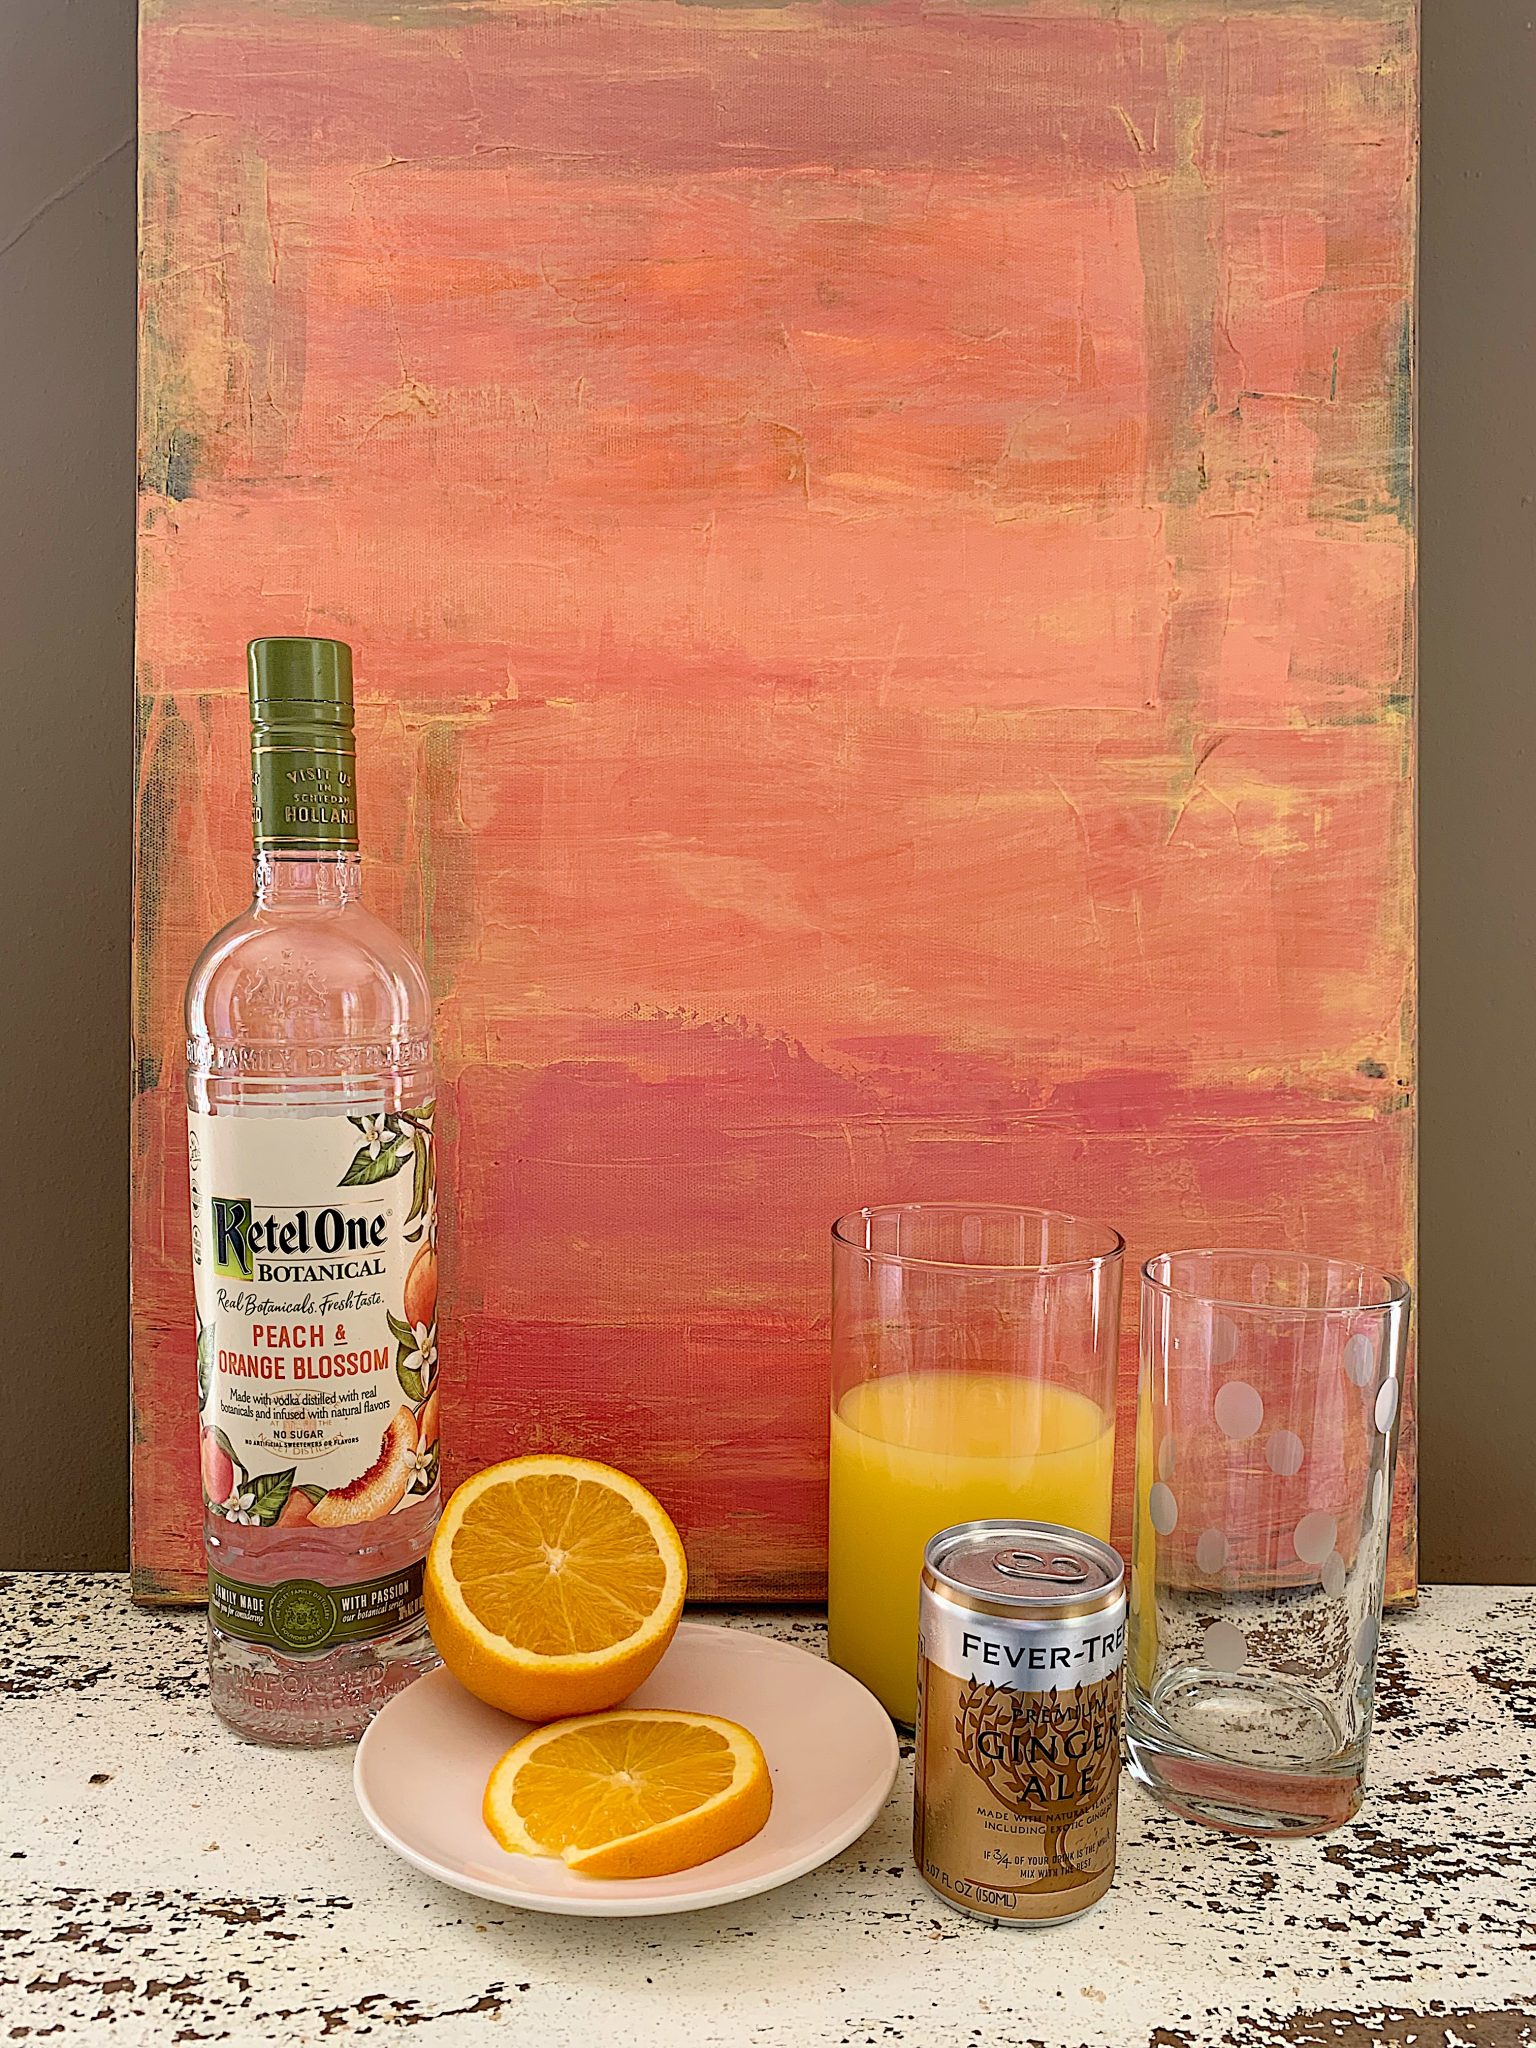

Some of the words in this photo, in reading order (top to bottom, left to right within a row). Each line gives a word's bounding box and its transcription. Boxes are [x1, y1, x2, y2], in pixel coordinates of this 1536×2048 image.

[286, 768, 331, 783] VISIT
[339, 771, 352, 786] US
[317, 784, 331, 792] IN
[285, 806, 355, 824] HOLLAND
[213, 1202, 311, 1275] Ketel
[314, 1208, 389, 1253] One
[257, 1259, 386, 1283] BOTANICAL
[217, 1288, 245, 1312] Real
[245, 1293, 317, 1316] Botanicals.
[319, 1290, 354, 1316] Fresh
[355, 1290, 385, 1310] taste.
[253, 1324, 324, 1348] PEACH
[334, 1324, 348, 1344] &
[219, 1349, 286, 1379] ORANGE
[294, 1347, 389, 1379] BLOSSOM
[230, 1387, 251, 1404] Made
[253, 1393, 271, 1406] with
[273, 1393, 300, 1406] vodka
[302, 1391, 337, 1406] distilled
[339, 1389, 359, 1402] with
[361, 1385, 377, 1400] real
[220, 1400, 254, 1418] botanicals
[256, 1407, 271, 1419] and
[273, 1407, 305, 1420] infused
[308, 1406, 328, 1419] with
[331, 1402, 361, 1418] natural
[364, 1399, 390, 1413] flavors
[273, 1430, 287, 1439] NO
[290, 1429, 324, 1439] SUGAR
[215, 1583, 237, 1605] FAMILY
[240, 1594, 264, 1612] MADE
[341, 1594, 367, 1611] WITH
[371, 1579, 409, 1606] PASSION
[342, 1613, 356, 1623] our
[357, 1602, 388, 1620] botanical
[1012, 1698, 1106, 1723] PREMIUM
[977, 1713, 1118, 1763] GINGER
[1018, 1764, 1096, 1802] ALE
[976, 1807, 1009, 1820] MADE
[1014, 1814, 1042, 1822] WITH
[1046, 1807, 1089, 1821] NATURAL
[984, 1820, 1046, 1834] INCLUDING
[1050, 1819, 1084, 1834] EXOTIC
[983, 1850, 991, 1860] IF
[1014, 1856, 1025, 1865] OF
[1028, 1856, 1049, 1866] YOUR
[1052, 1851, 1075, 1863] DRINK
[1077, 1848, 1083, 1859] IS
[1085, 1842, 1096, 1855] THE
[1020, 1869, 1035, 1879] MIX
[1038, 1868, 1058, 1879] WITH
[1061, 1865, 1073, 1875] THE
[1076, 1858, 1091, 1871] BEST
[941, 1871, 952, 1889] FL
[954, 1880, 972, 1898] OZ
[975, 1886, 1017, 1909] (150ML)
